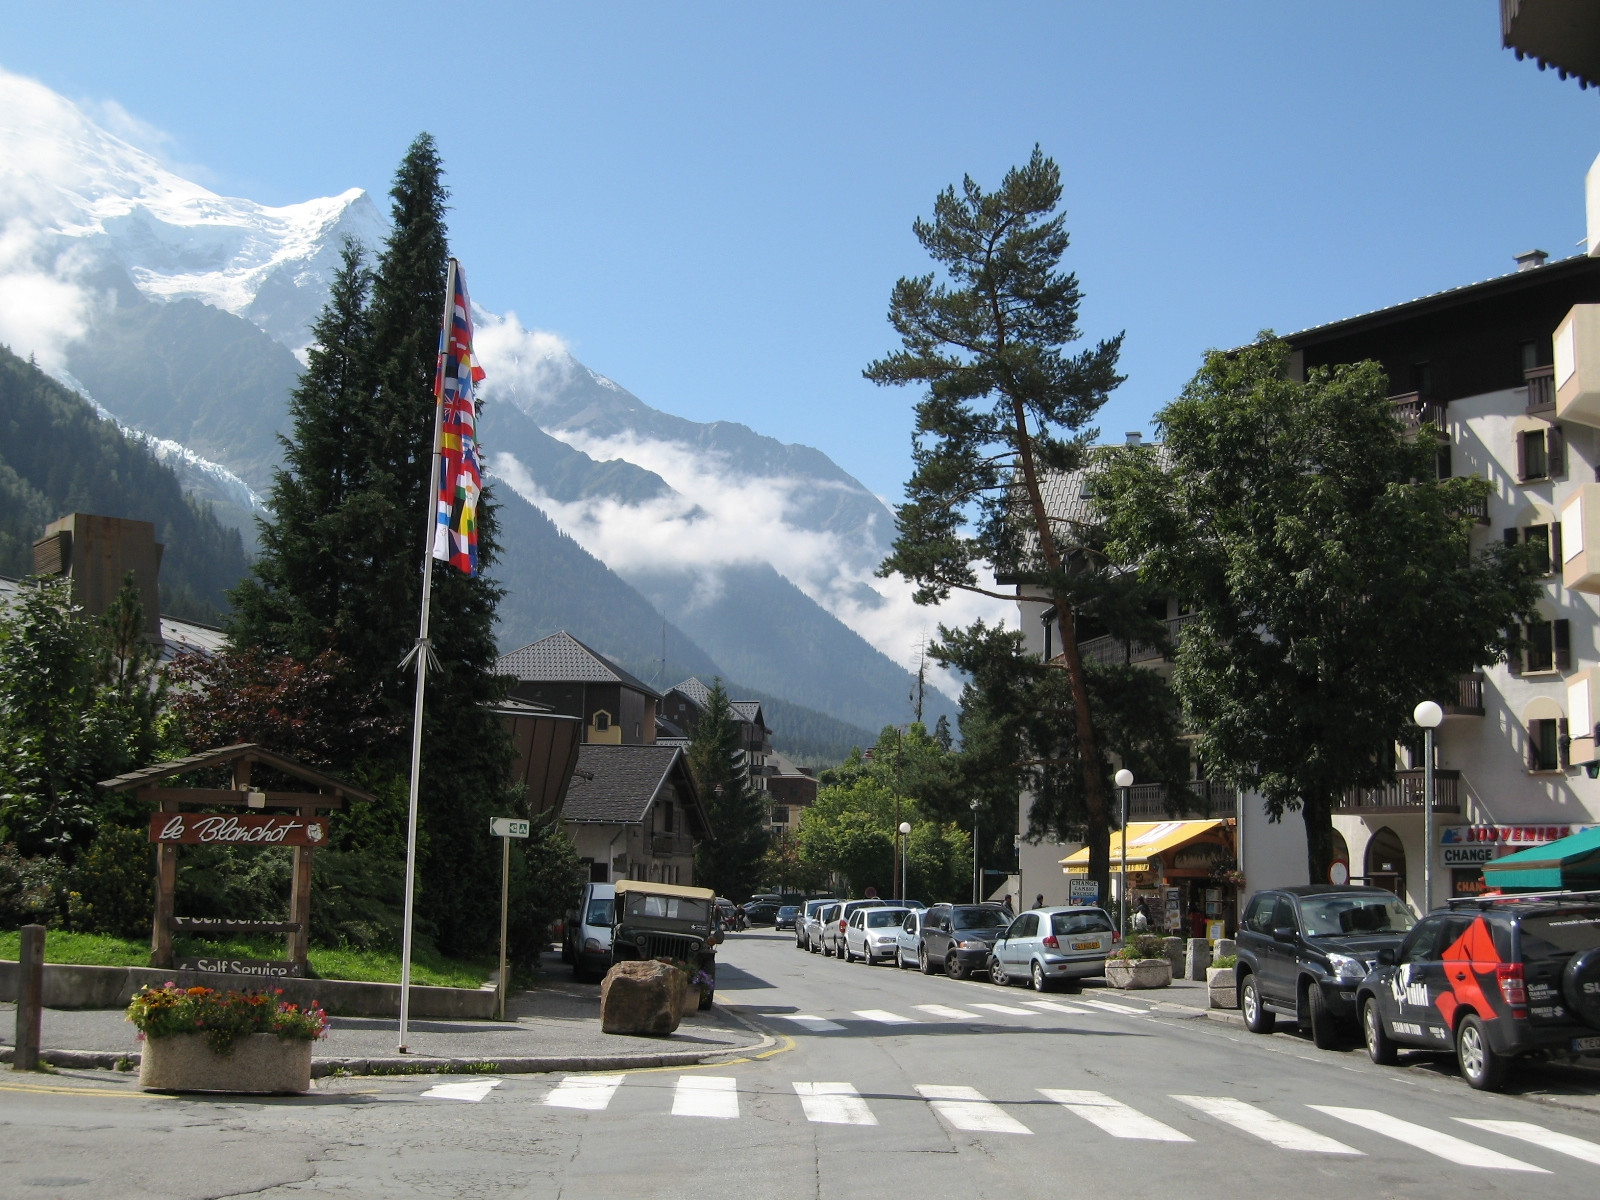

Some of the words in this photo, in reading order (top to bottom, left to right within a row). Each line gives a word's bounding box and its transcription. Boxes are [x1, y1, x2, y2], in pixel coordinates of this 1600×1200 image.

[159, 815, 185, 839] le
[192, 816, 303, 842] Blanchot
[1466, 826, 1570, 842] SOUVENIRS
[1444, 849, 1492, 861] CHANGE
[197, 959, 229, 973] Self
[231, 961, 288, 976] Service
